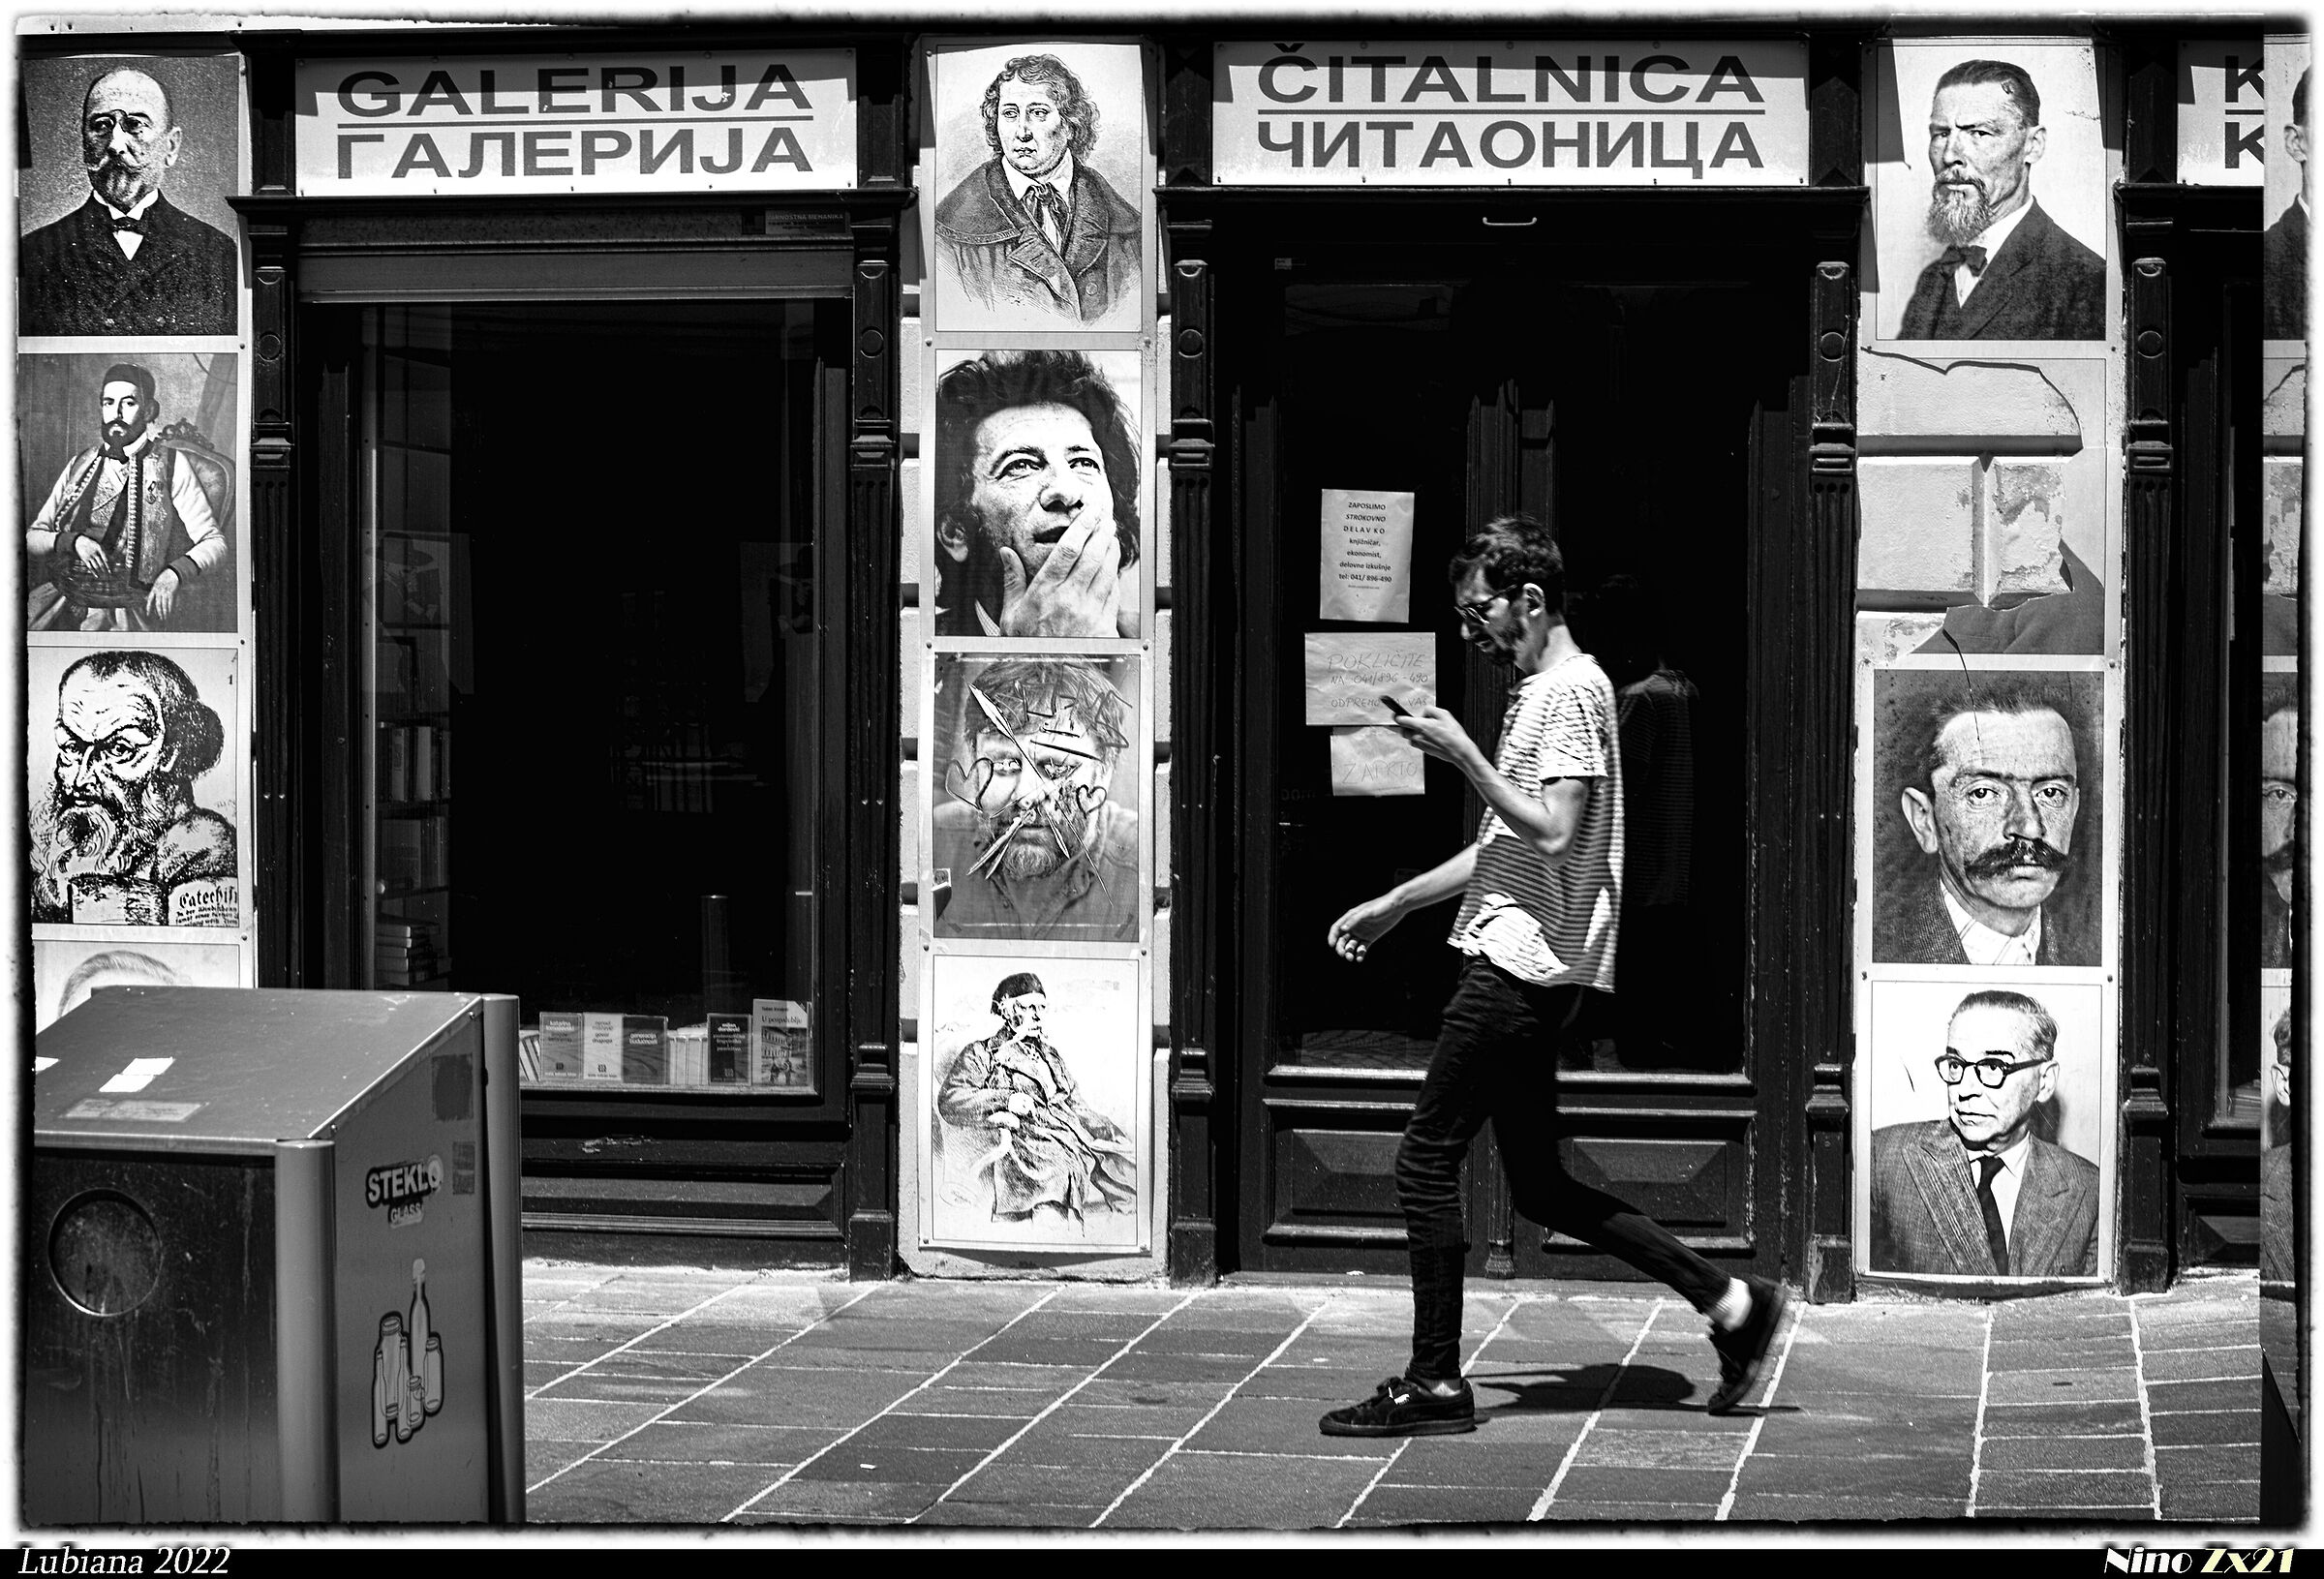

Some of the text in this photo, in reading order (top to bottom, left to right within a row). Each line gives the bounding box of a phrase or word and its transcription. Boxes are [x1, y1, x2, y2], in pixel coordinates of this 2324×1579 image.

[1258, 42, 1766, 104] ČITALNICA
[336, 64, 814, 118] GALERIJA
[336, 126, 814, 180] ГАЛЕРИЈА
[1258, 119, 1766, 180] ЧИТАОНИЦА
[1348, 501, 1387, 511] ZAPOSLIMO
[1345, 513, 1387, 523] STROKOVNO
[1346, 550, 1382, 559] ekonomist,
[1365, 562, 1391, 571] izkušnje
[1330, 675, 1345, 685] NA
[368, 1159, 442, 1202] STEKLO
[390, 1201, 422, 1223] GLASS
